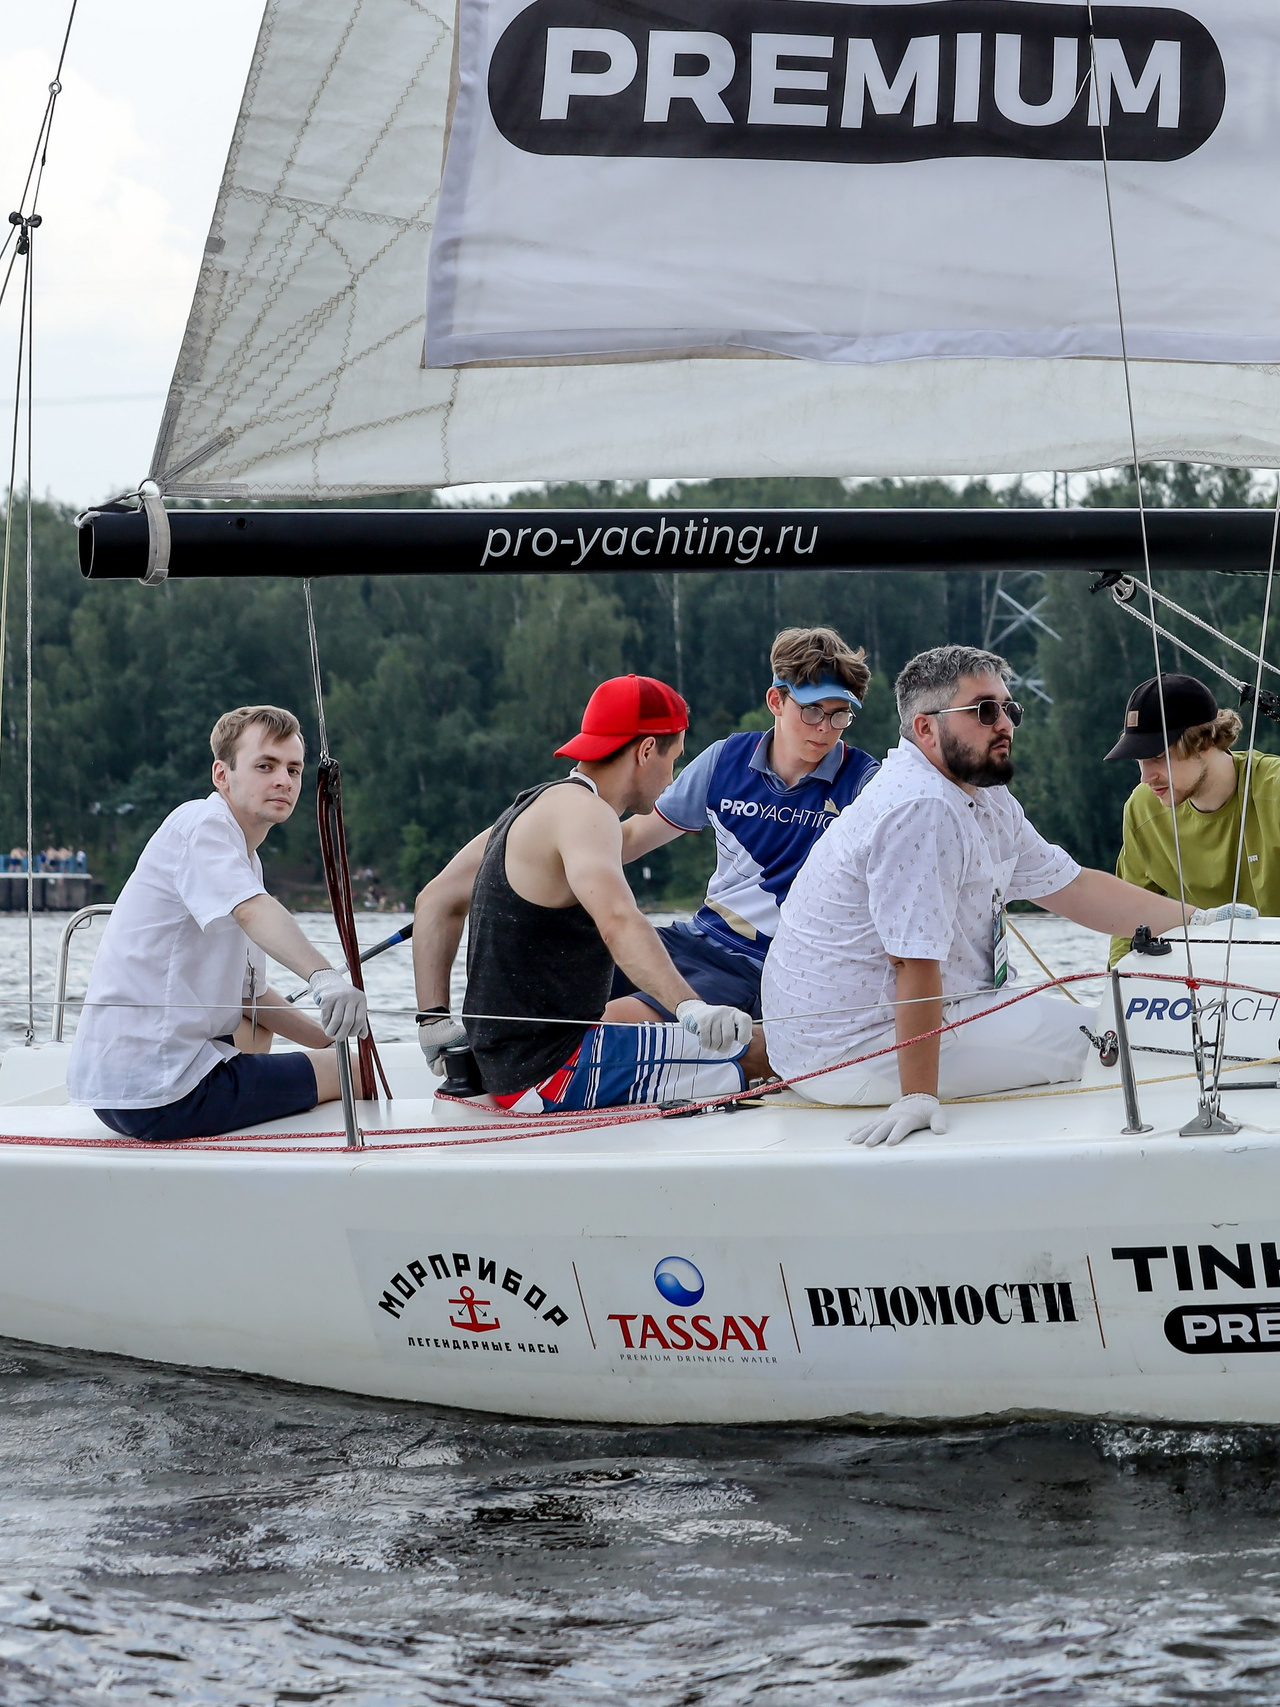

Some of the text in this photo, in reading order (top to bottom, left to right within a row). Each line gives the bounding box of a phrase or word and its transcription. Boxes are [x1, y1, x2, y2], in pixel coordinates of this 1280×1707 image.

[539, 26, 1182, 130] PREMIUM
[480, 517, 819, 566] pro-yachting.ru
[378, 1253, 569, 1327] МОРПРИБОР
[804, 1281, 1080, 1333] ВЕДОМОСТИ
[408, 1336, 559, 1354] ЛЕГЕНДАРНЫЕ ЧАСЫ
[607, 1314, 771, 1351] TASSAY
[620, 1354, 778, 1364] PREMIUM DRINKING WATER
